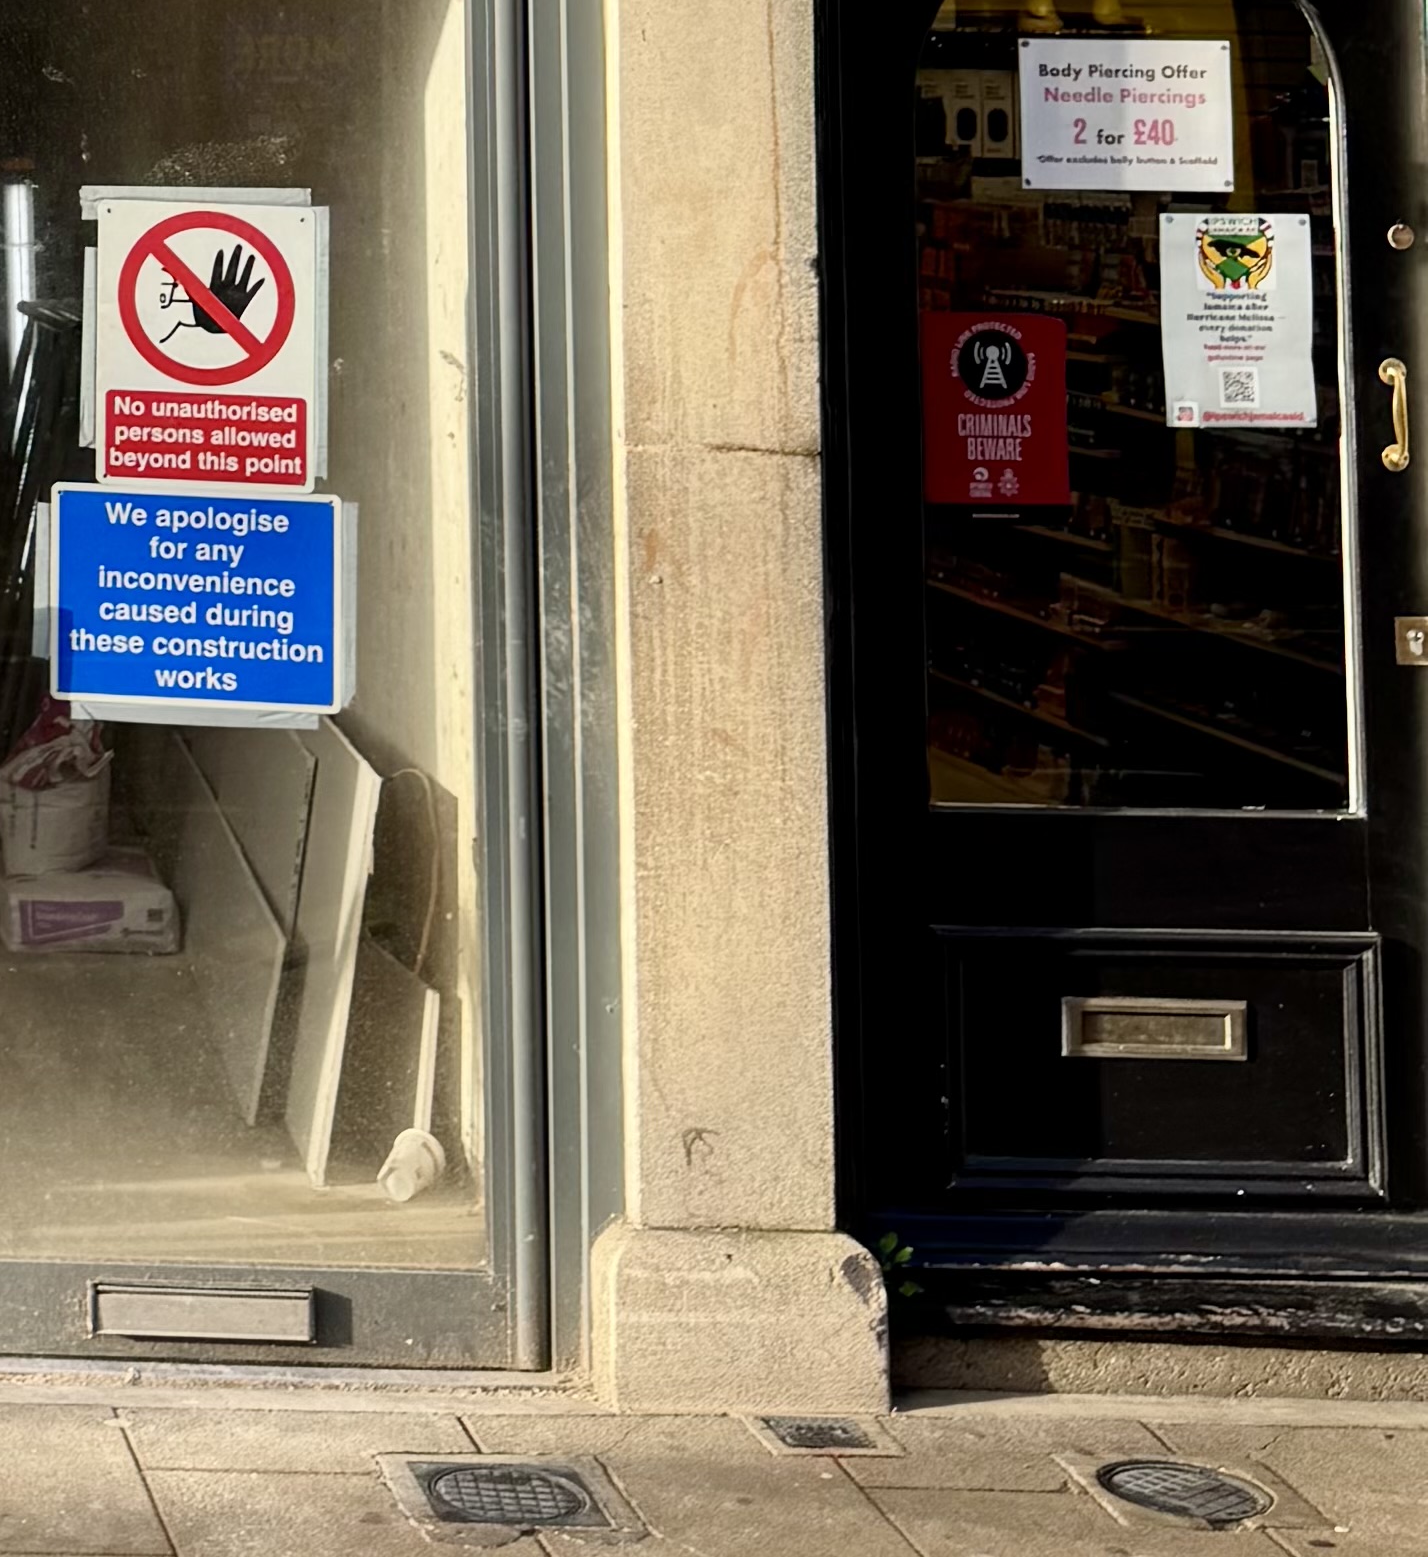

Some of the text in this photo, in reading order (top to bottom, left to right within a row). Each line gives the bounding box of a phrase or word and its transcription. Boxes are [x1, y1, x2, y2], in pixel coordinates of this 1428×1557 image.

[1039, 63, 1207, 82] Body Piercing Offer
[1044, 87, 1206, 108] Needle Piercings
[1073, 118, 1087, 144] 2
[1097, 129, 1124, 145] for
[115, 396, 298, 423] No unauthorised
[115, 426, 296, 448] persons allowed
[958, 413, 1032, 437] CRIMINALS
[110, 447, 301, 476] beyond this point
[967, 438, 1022, 461] BEWARE
[105, 502, 289, 536] We apologise
[150, 536, 244, 568] for any
[99, 563, 295, 597] inconvenience
[100, 602, 293, 634] caused during
[70, 628, 323, 662] these construction
[155, 667, 237, 691] works
